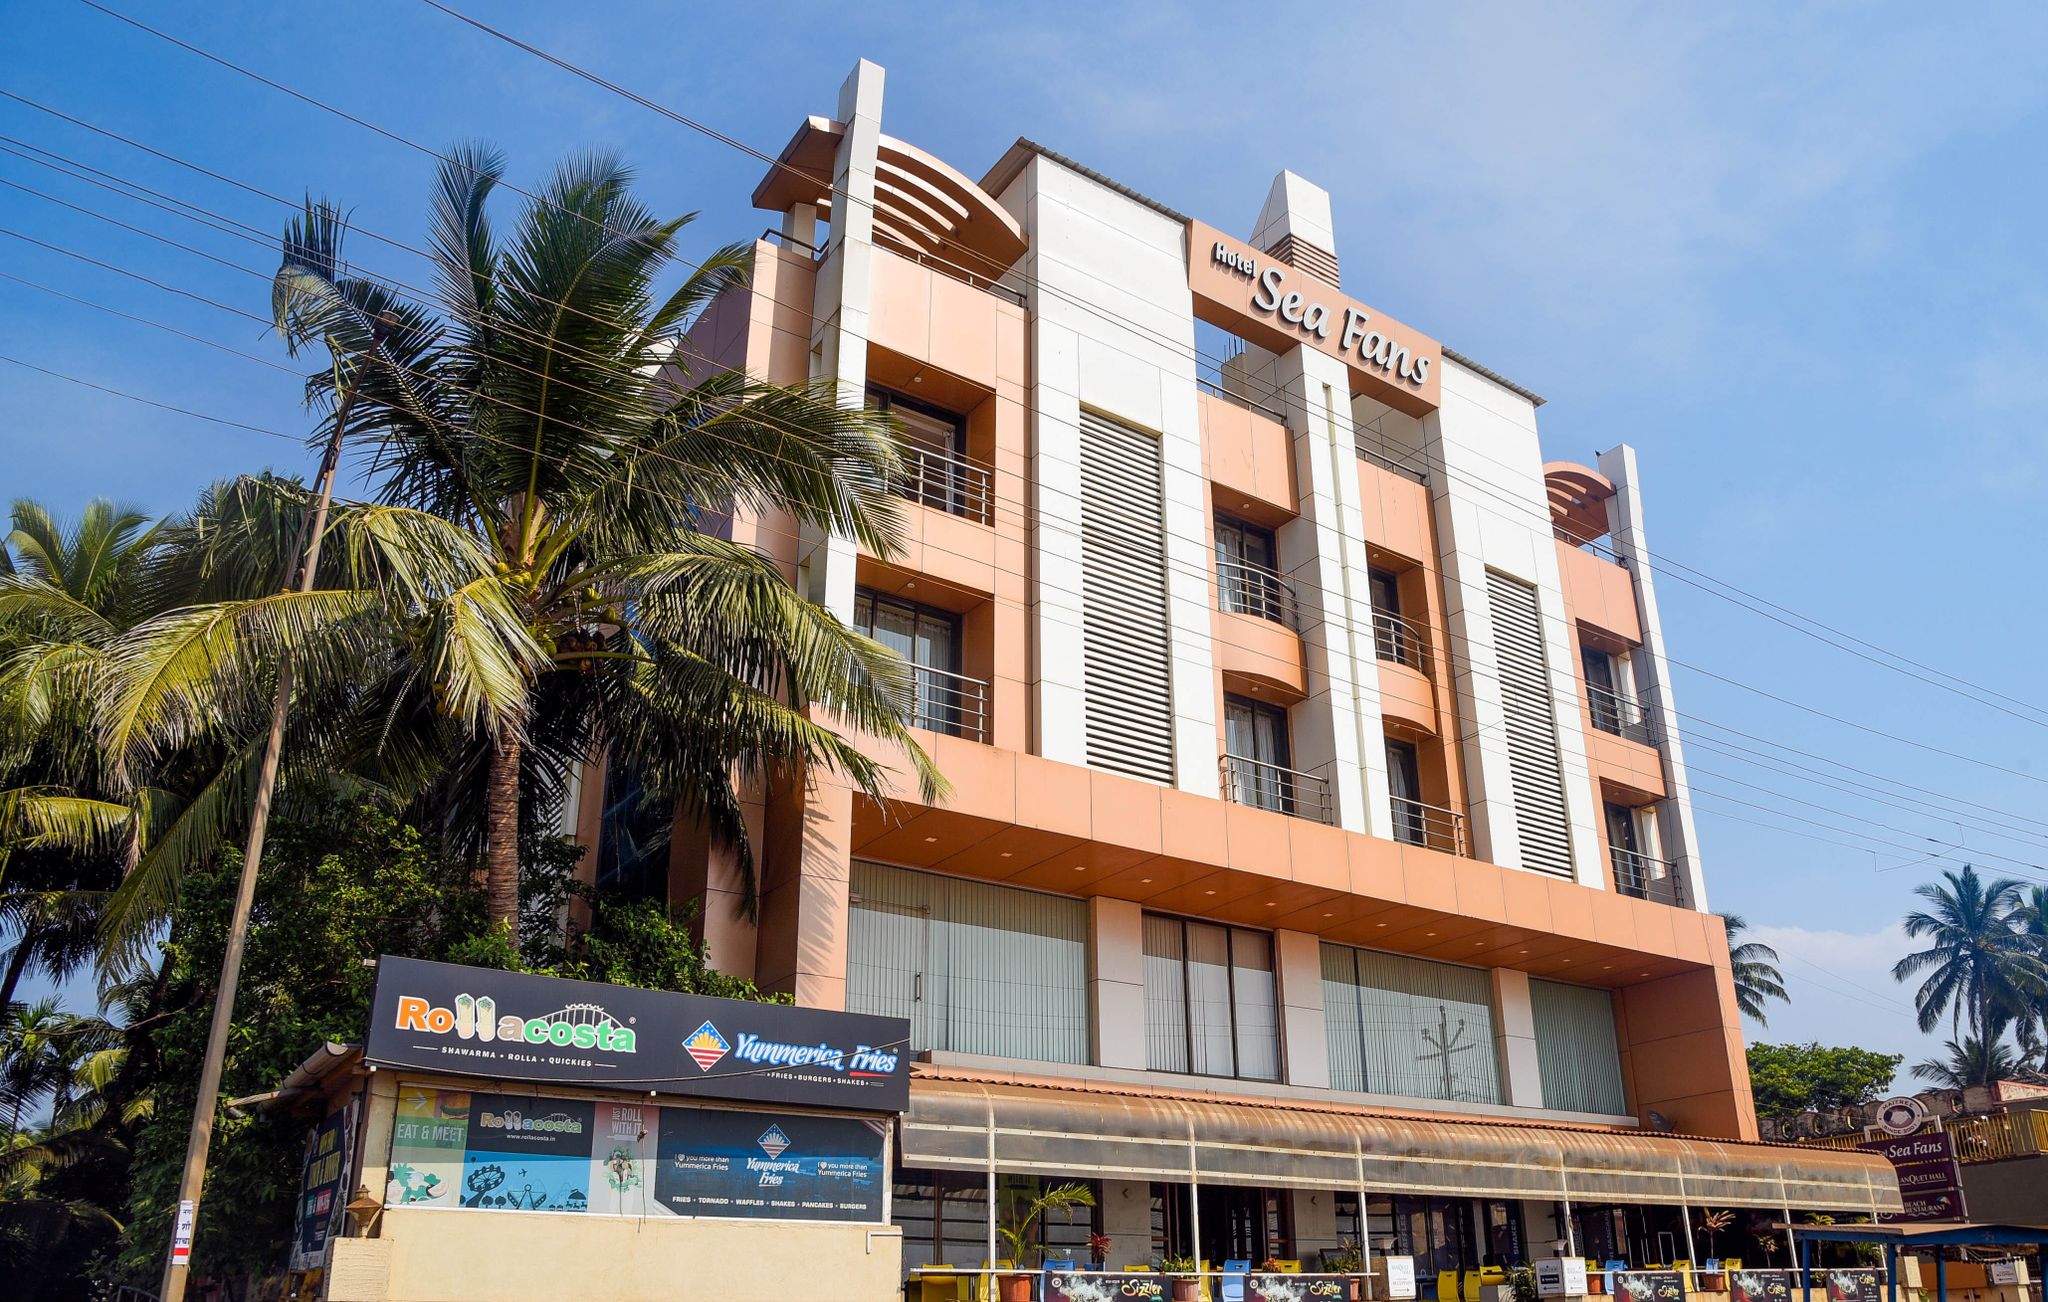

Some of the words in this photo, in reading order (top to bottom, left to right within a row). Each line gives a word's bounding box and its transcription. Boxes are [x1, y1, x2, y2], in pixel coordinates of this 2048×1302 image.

[1215, 240, 1257, 278] Hotel
[1253, 266, 1331, 338] Sea
[1342, 305, 1431, 385] Fans
[395, 992, 637, 1054] Rollacosta
[441, 1046, 496, 1059] SHAWARMA
[508, 1053, 537, 1063] ROLLA
[548, 1057, 592, 1067] QUICKIES
[735, 1032, 844, 1071] Yummerica
[849, 1044, 898, 1073] Fries
[771, 1071, 793, 1080] FRIES
[797, 1074, 832, 1084] BURGERS
[837, 1077, 865, 1086] SHAKES
[1882, 1099, 1915, 1110] MAITREE
[621, 1107, 642, 1122] ROLL
[396, 1123, 419, 1138] EAT
[421, 1125, 429, 1141] &
[432, 1126, 464, 1143] MEET
[611, 1121, 632, 1135] WITH
[633, 1122, 642, 1136] IT
[1884, 1125, 1902, 1135] SINCE
[507, 1134, 556, 1143] www.rollacosta.in
[1889, 1144, 1911, 1158] Sea
[1913, 1141, 1942, 1156] Fans
[674, 1161, 711, 1170] Yummerica
[712, 1162, 729, 1171] Fries
[686, 1155, 697, 1163] you
[715, 1155, 730, 1163] than
[746, 1157, 800, 1173] Yummerica
[817, 1168, 852, 1178] Yummerica
[852, 1170, 868, 1178] Fries
[827, 1163, 838, 1171] you
[854, 1163, 868, 1171] than
[758, 1172, 784, 1185] Fries
[1900, 1174, 1928, 1184] ANQUET
[1929, 1172, 1947, 1180] HALL
[672, 1195, 691, 1203] FRIES
[698, 1197, 729, 1205] TORNADO
[735, 1198, 765, 1206] WAFFLES
[801, 1201, 834, 1209] PANCAKES
[1905, 1204, 1946, 1213] RESTAURANT
[1121, 1278, 1163, 1298] Sizzler
